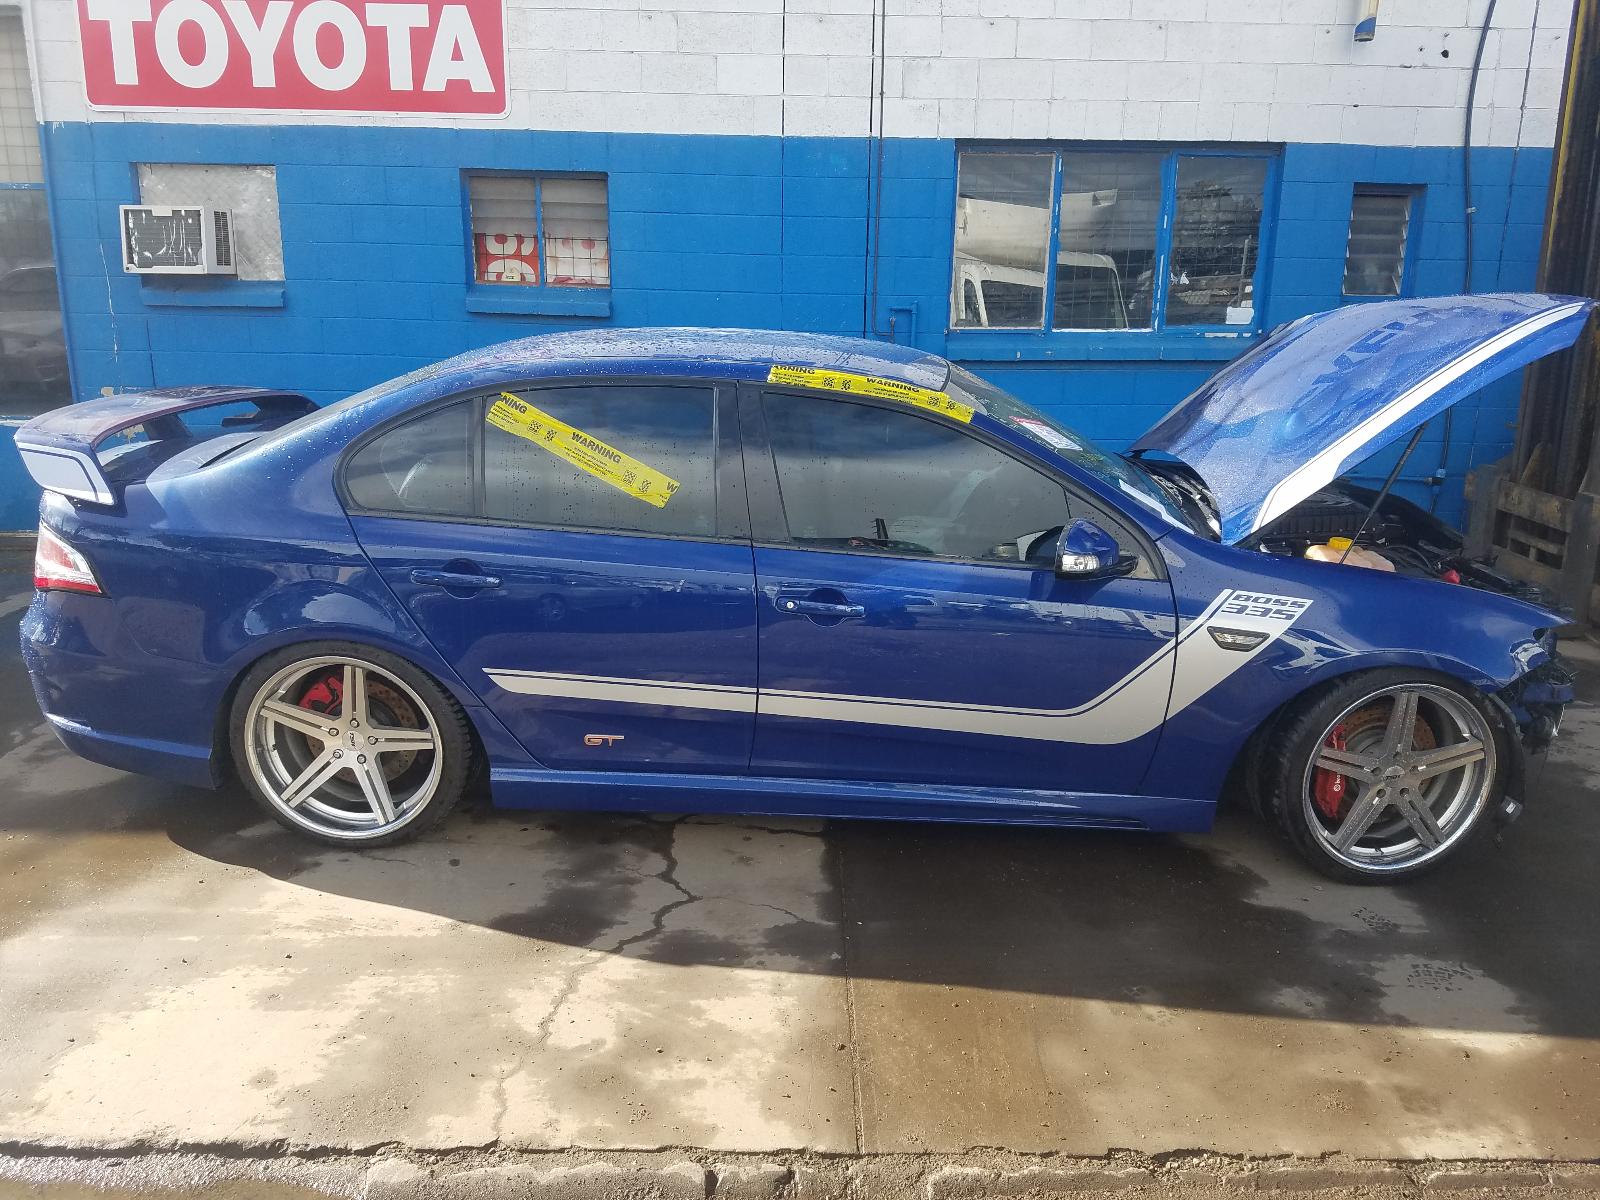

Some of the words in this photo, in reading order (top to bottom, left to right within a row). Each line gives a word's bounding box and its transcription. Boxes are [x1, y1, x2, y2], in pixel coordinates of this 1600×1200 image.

[88, 0, 496, 92] TOYOTA
[866, 377, 920, 393] WARNING
[571, 431, 622, 464] WARNING
[1231, 593, 1308, 609] BOSS
[1221, 602, 1299, 621] 335
[583, 733, 625, 747] GT
